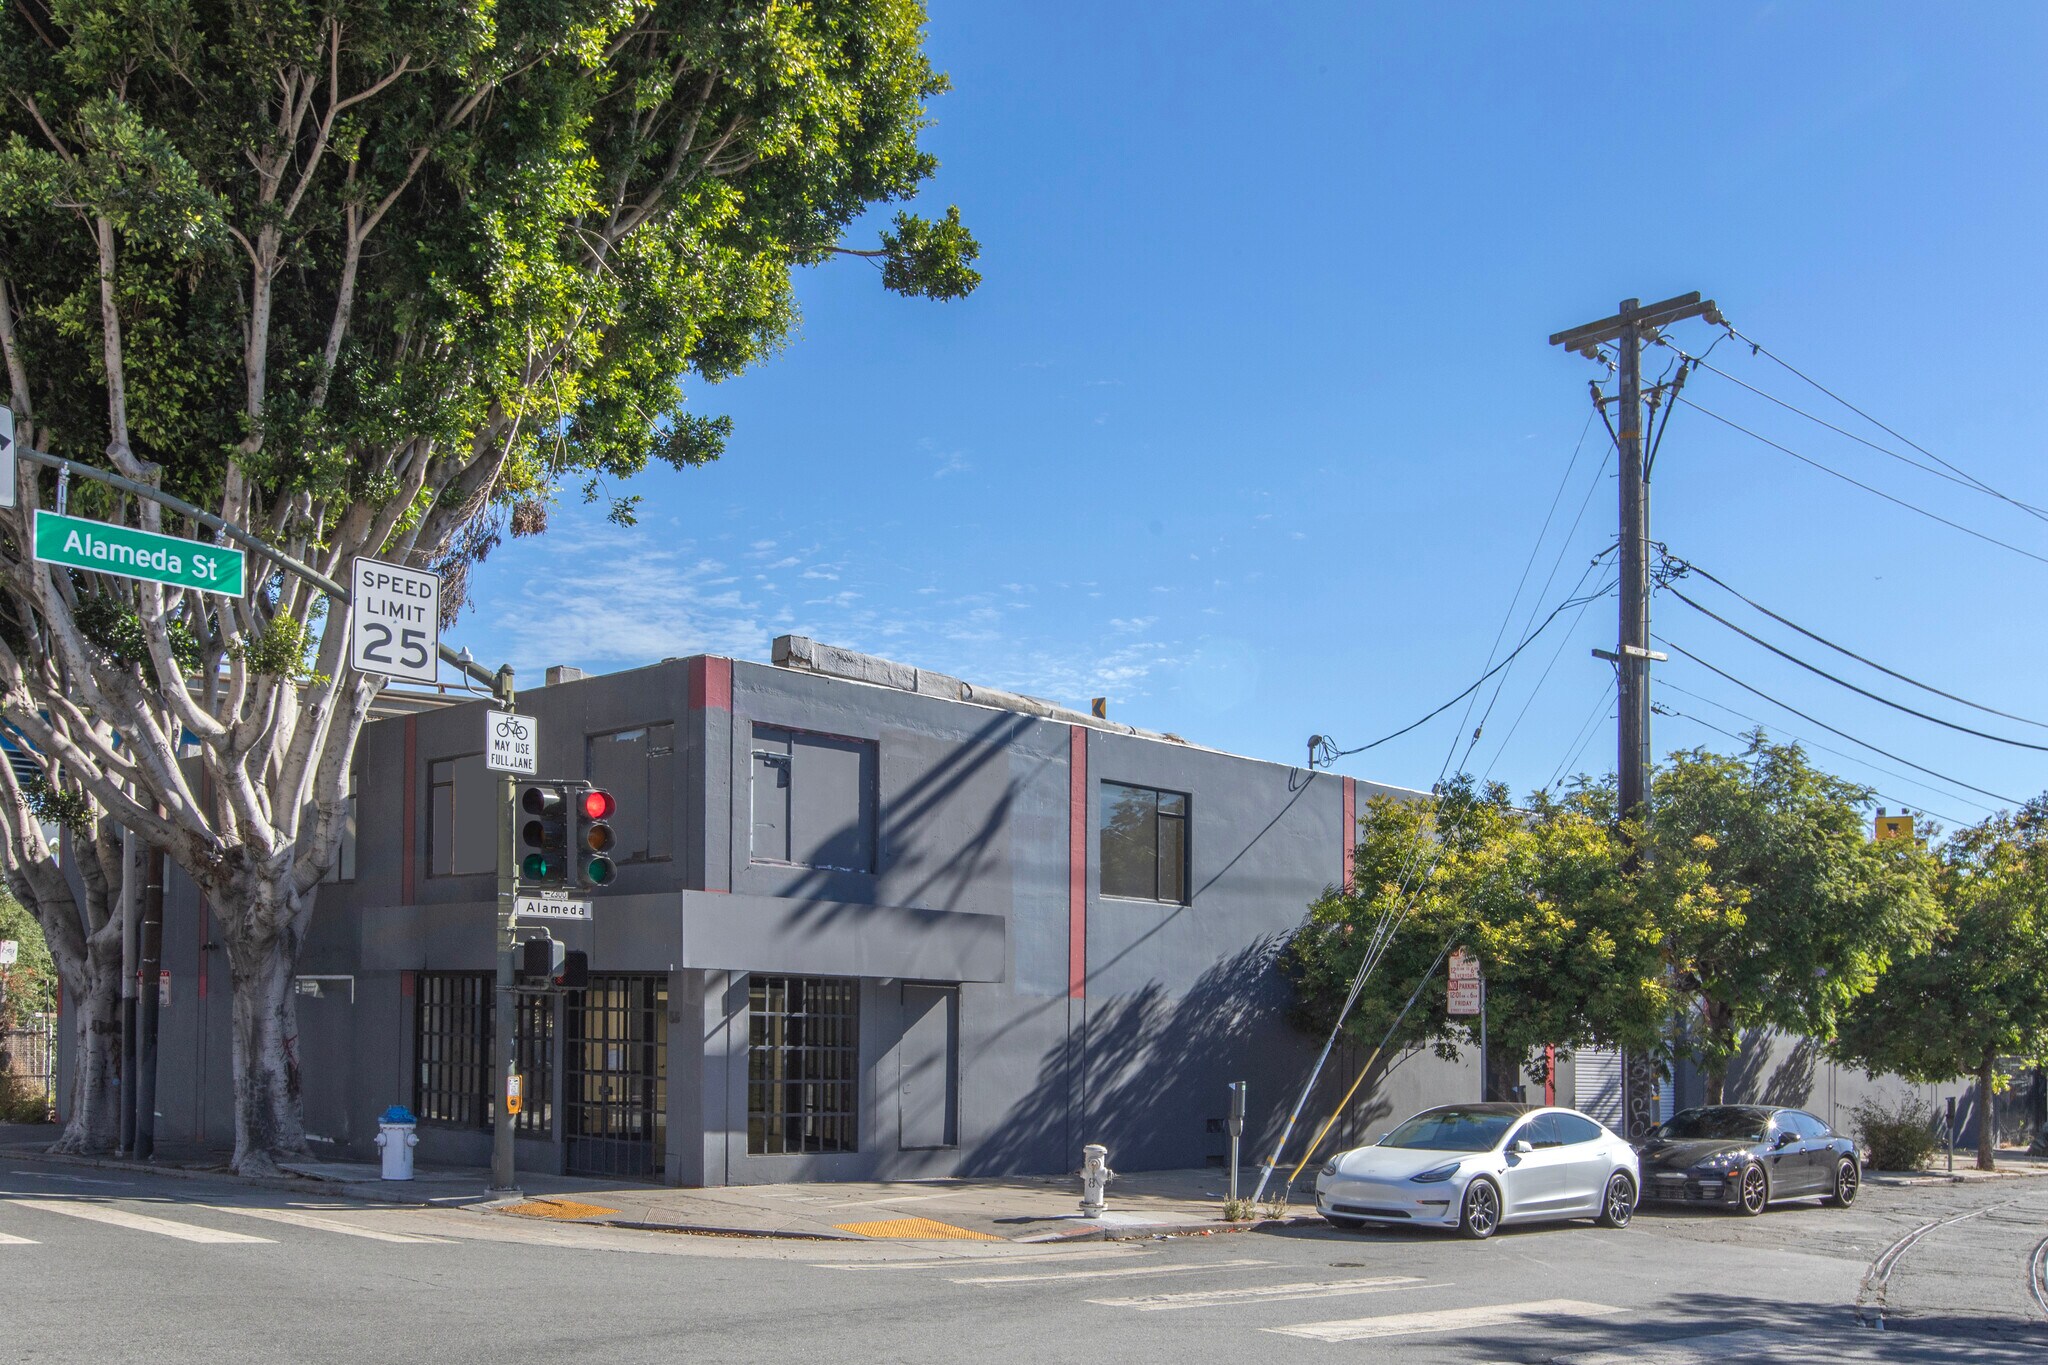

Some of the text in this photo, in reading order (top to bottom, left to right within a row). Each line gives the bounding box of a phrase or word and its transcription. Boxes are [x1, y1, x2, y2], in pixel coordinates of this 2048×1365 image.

[63, 529, 218, 581] Alameda St
[362, 570, 432, 599] SPEED
[367, 596, 426, 623] LIMIT
[362, 622, 429, 669] 25
[494, 739, 530, 755] MAY USE
[491, 753, 533, 770] FULL LANE
[526, 901, 585, 916] Alameda
[1449, 981, 1458, 990] NO
